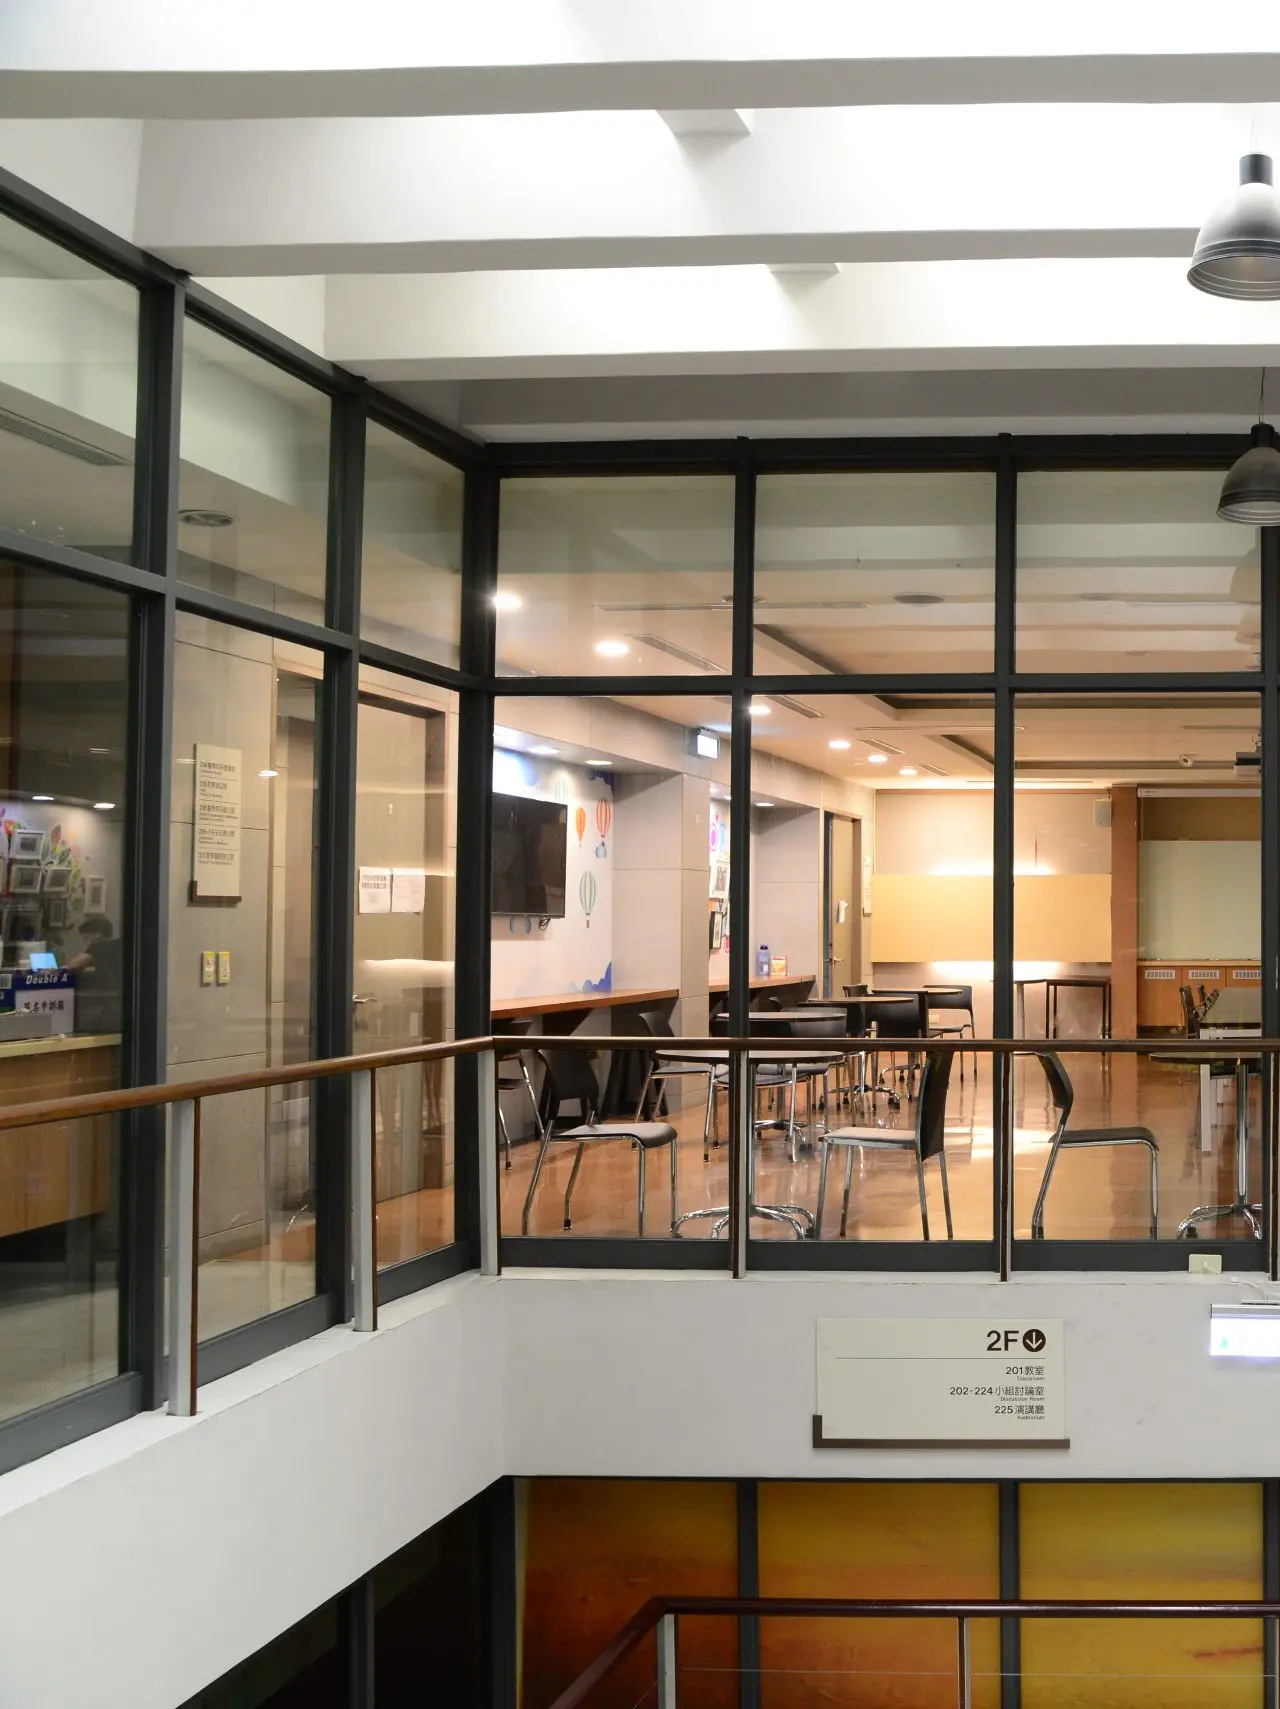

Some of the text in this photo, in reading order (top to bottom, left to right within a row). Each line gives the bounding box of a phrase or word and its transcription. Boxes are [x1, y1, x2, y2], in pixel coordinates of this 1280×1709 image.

[25, 973, 68, 985] Double A
[986, 1330, 1020, 1351] 2F
